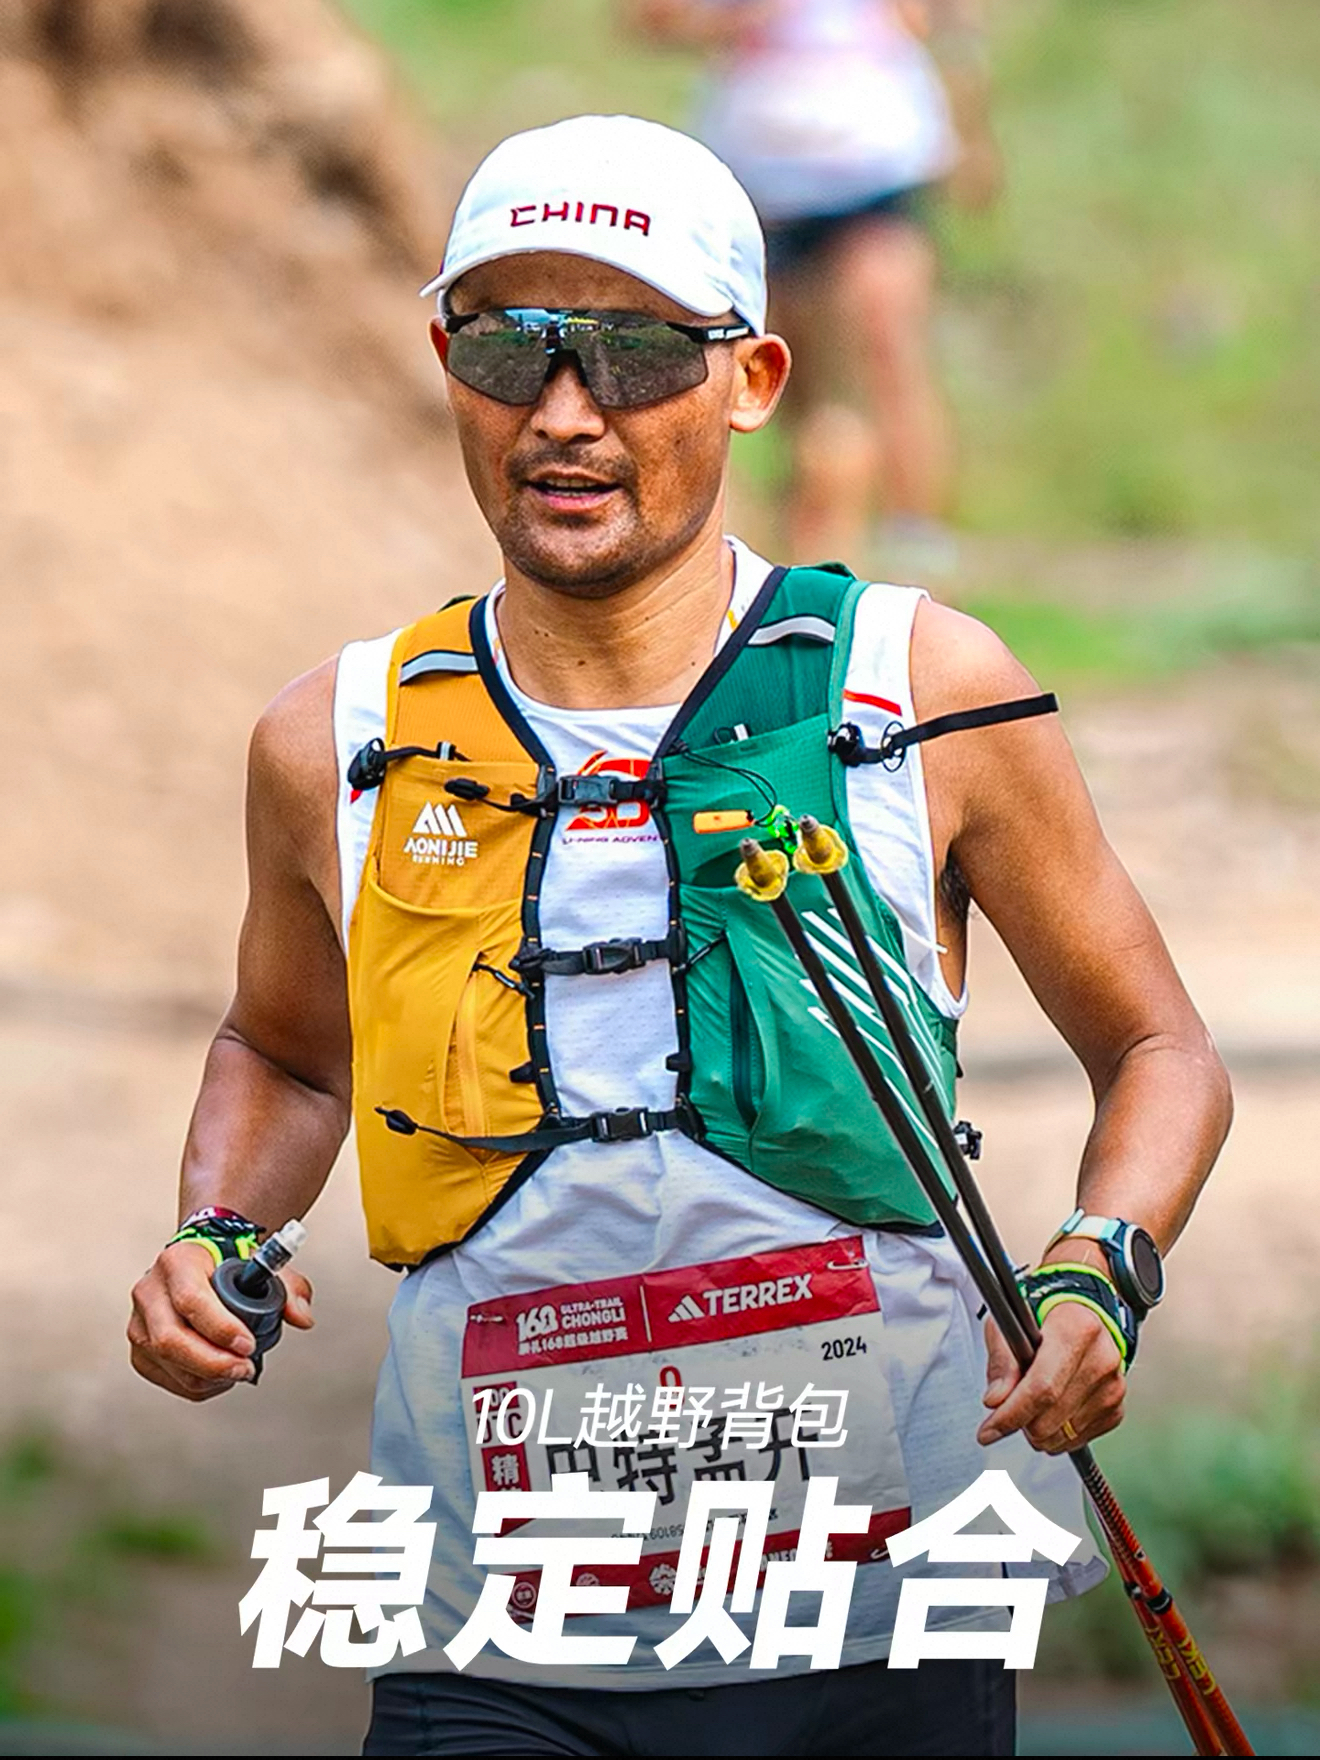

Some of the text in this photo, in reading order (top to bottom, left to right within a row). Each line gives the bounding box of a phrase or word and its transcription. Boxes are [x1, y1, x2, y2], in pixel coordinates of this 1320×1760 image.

[510, 201, 651, 237] CHINA
[403, 837, 479, 858] AONIJIE
[702, 1272, 814, 1316] TERREX
[561, 1307, 627, 1329] CHONGLI
[821, 1336, 868, 1361] 2024
